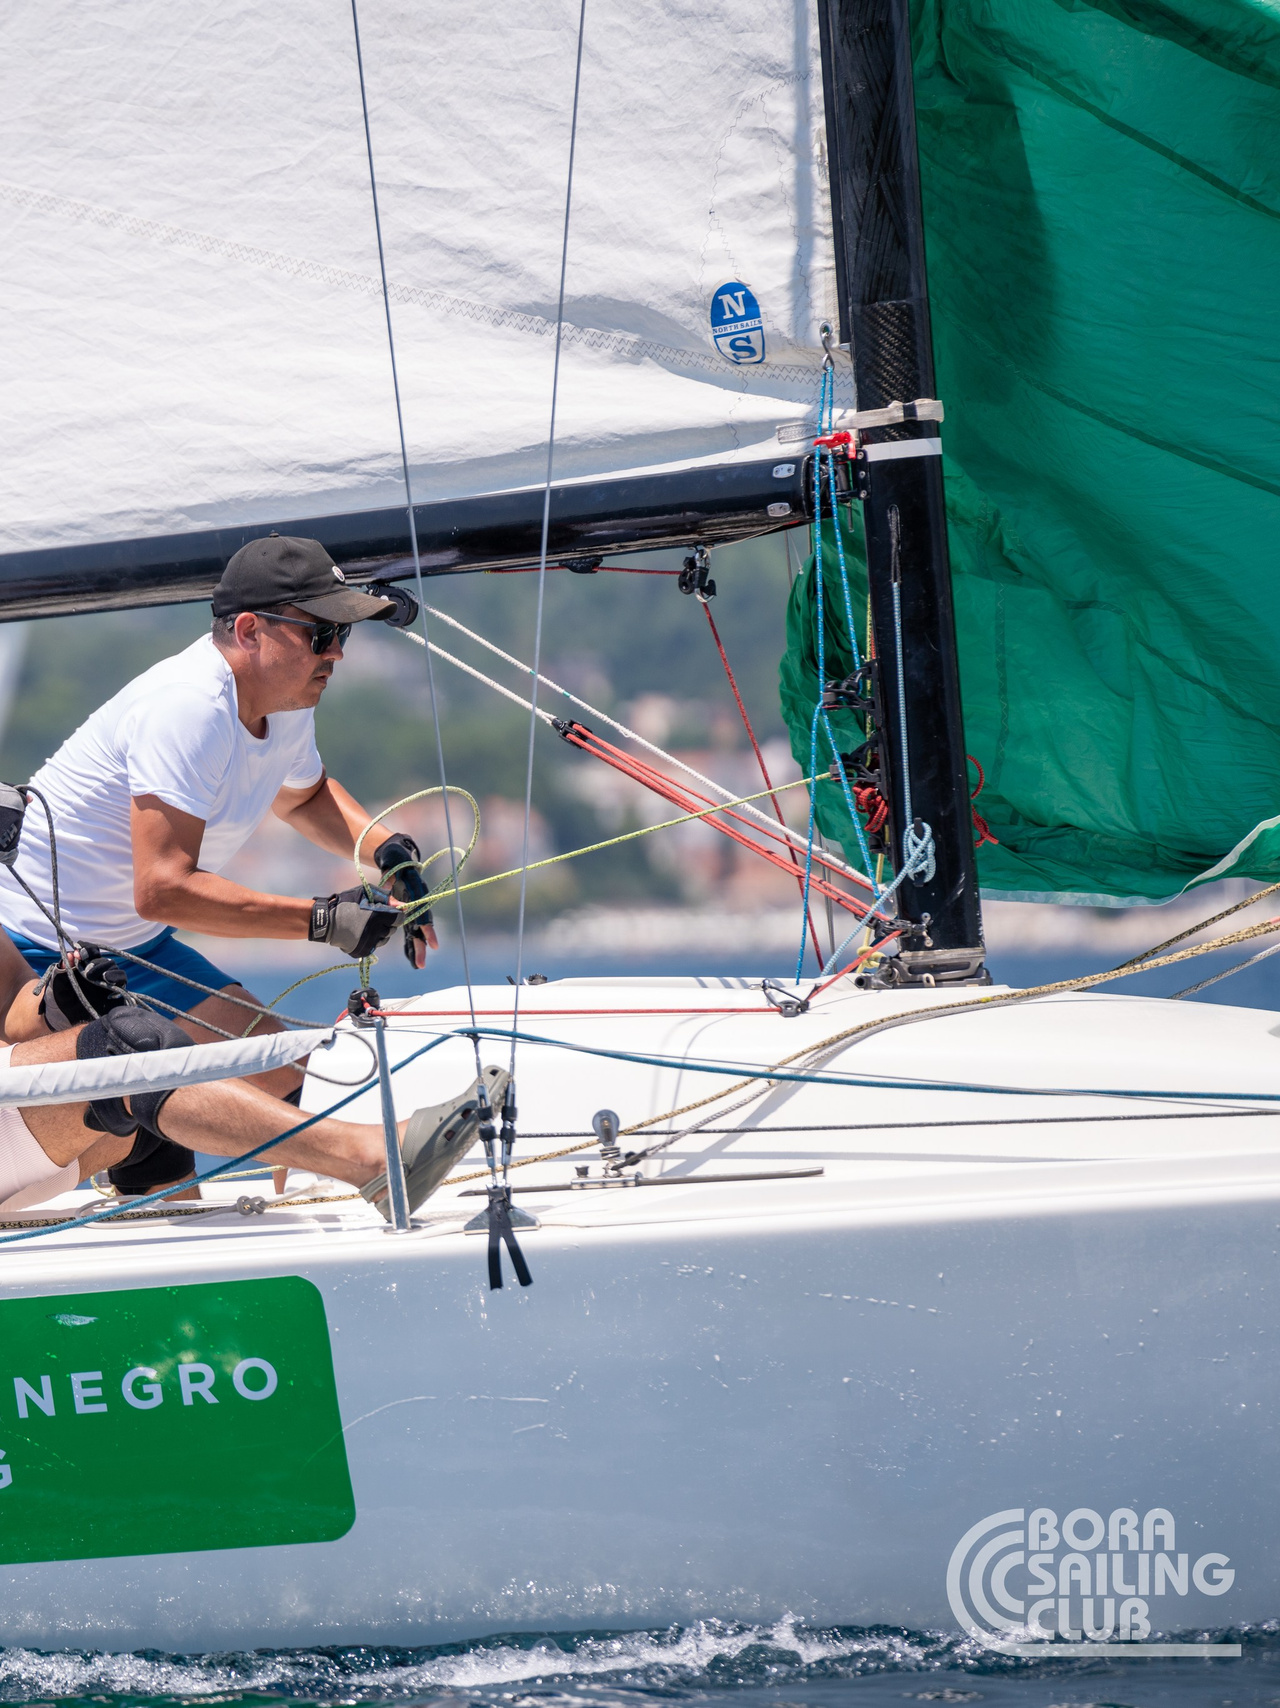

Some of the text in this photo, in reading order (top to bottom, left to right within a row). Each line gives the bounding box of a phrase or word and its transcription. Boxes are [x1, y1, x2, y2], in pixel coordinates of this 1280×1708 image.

[718, 291, 746, 319] N
[712, 319, 763, 334] NORTH SAILS
[729, 335, 758, 361] S
